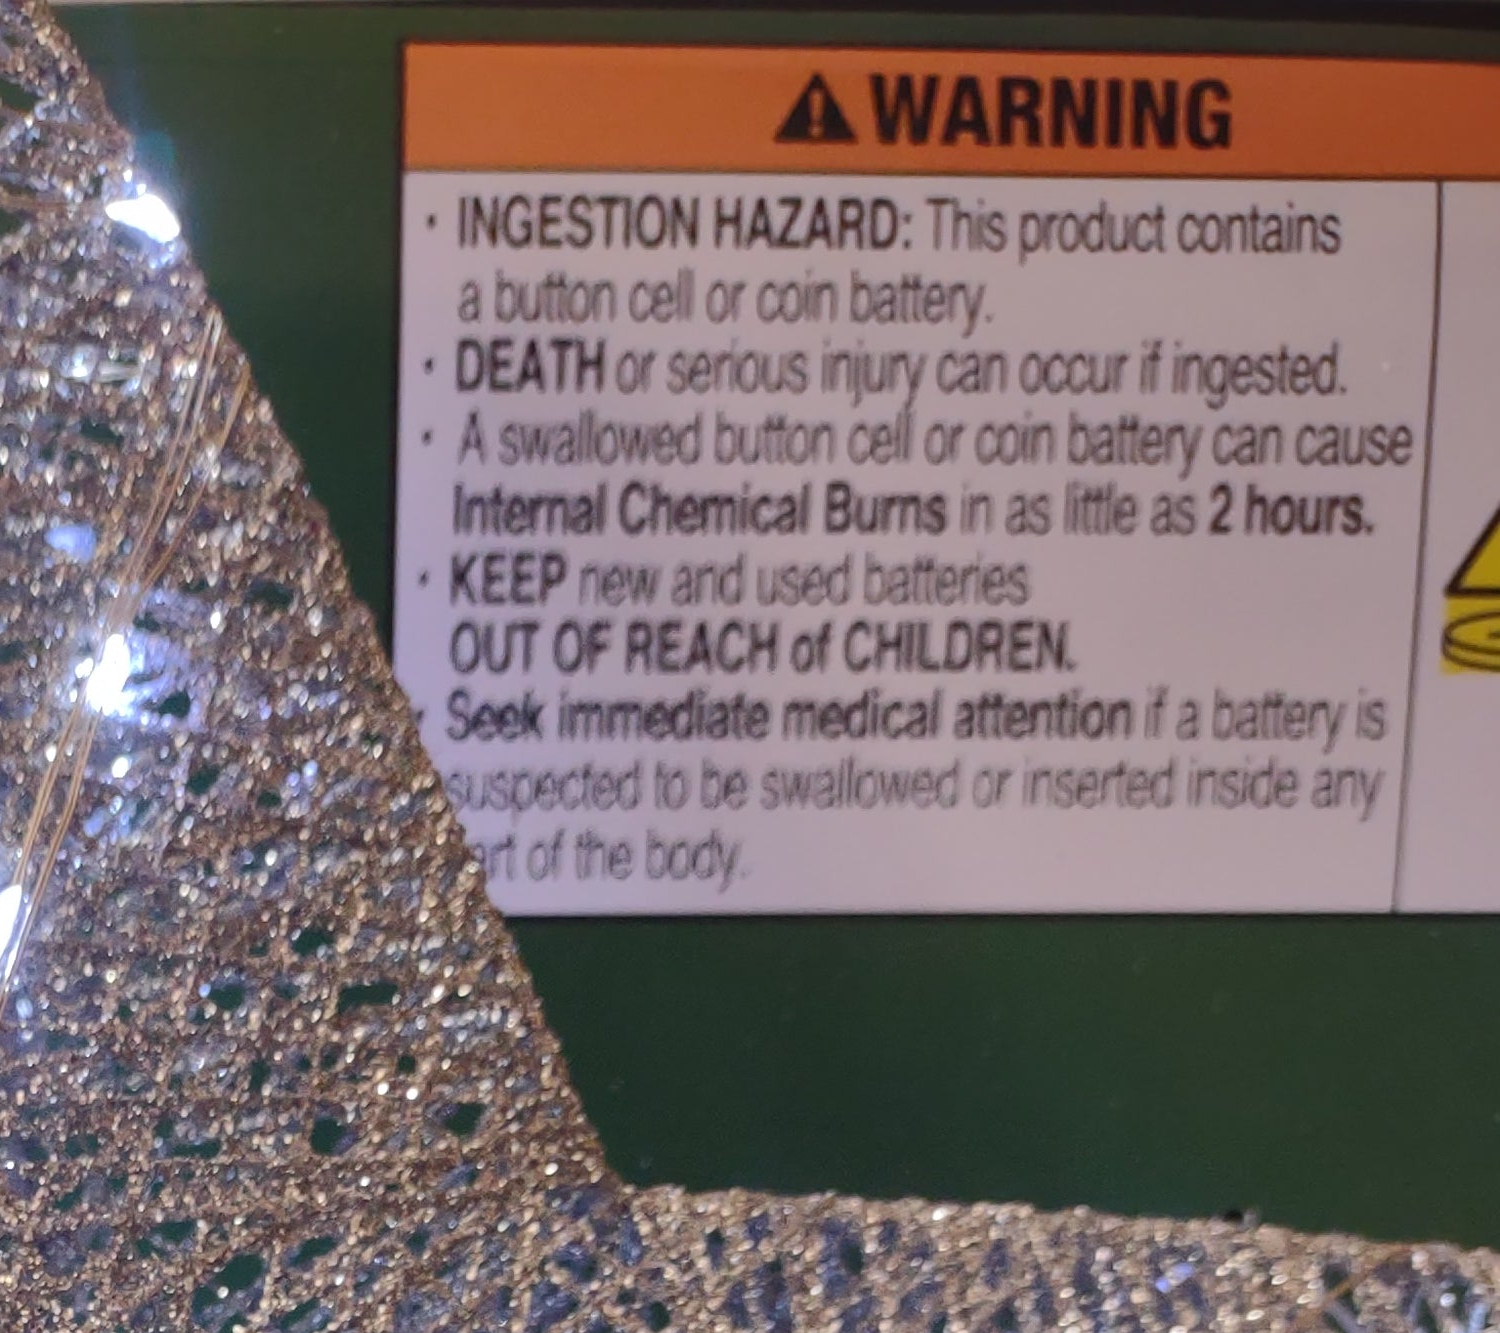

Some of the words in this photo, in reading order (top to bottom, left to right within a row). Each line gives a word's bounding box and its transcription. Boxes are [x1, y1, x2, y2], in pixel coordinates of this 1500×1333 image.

[867, 74, 1233, 148] WARNING
[457, 196, 698, 249] INGESTION
[714, 200, 913, 252] HAZARD:
[927, 200, 1008, 253] This
[1018, 203, 1167, 262] product
[1176, 208, 1342, 256] contains
[459, 283, 482, 321] a
[496, 270, 617, 321] button
[628, 268, 693, 321] cell
[705, 282, 746, 321] or
[756, 271, 839, 321] coin
[851, 273, 993, 336] battery.
[456, 340, 606, 391] DEATH
[617, 354, 657, 391] or
[667, 342, 808, 393] serious
[820, 341, 922, 409] injury
[936, 354, 1007, 393] can
[1020, 355, 1126, 394] occur
[1138, 340, 1162, 393] if
[1173, 341, 1346, 410] ingested.
[459, 414, 487, 462] A
[498, 413, 698, 465] swallowed
[715, 413, 833, 465] button
[844, 413, 913, 465] cell
[924, 426, 962, 465] or
[975, 413, 1058, 465] coin
[1069, 415, 1200, 480] battery
[1211, 428, 1284, 466] can
[1295, 428, 1413, 466] cause
[454, 482, 606, 535] Internal
[619, 482, 810, 535] Chemical
[824, 483, 947, 535] Burns
[961, 485, 994, 535] in
[1005, 497, 1053, 535] as
[1062, 483, 1138, 535] little
[1150, 497, 1197, 535] as
[1208, 485, 1233, 535] 2
[1244, 485, 1375, 536] hours.
[450, 555, 567, 601] KEEP
[580, 566, 658, 602] new
[671, 553, 744, 604] and
[756, 553, 852, 604] used
[864, 555, 1029, 605] batteries
[450, 622, 539, 671] OUT
[553, 622, 612, 671] OF
[625, 622, 776, 672] REACH
[791, 619, 832, 672] of
[844, 622, 1076, 672] CHILDREN.
[447, 689, 544, 740] Seek
[558, 689, 769, 740] immediate
[782, 689, 938, 740] medical
[953, 689, 1132, 740] attention
[1145, 688, 1167, 740] if
[1176, 702, 1200, 740] a
[1211, 688, 1343, 754] battery
[1356, 691, 1384, 740] is
[448, 761, 642, 822] suspected
[654, 761, 689, 808] to
[701, 761, 750, 809] be
[762, 759, 958, 810] swallowed
[973, 772, 1011, 810] or
[1023, 761, 1174, 810] inserted
[1187, 761, 1297, 810] inside
[1310, 774, 1382, 822] any
[528, 828, 566, 880] of
[574, 828, 632, 880] the
[645, 828, 748, 894] body.
